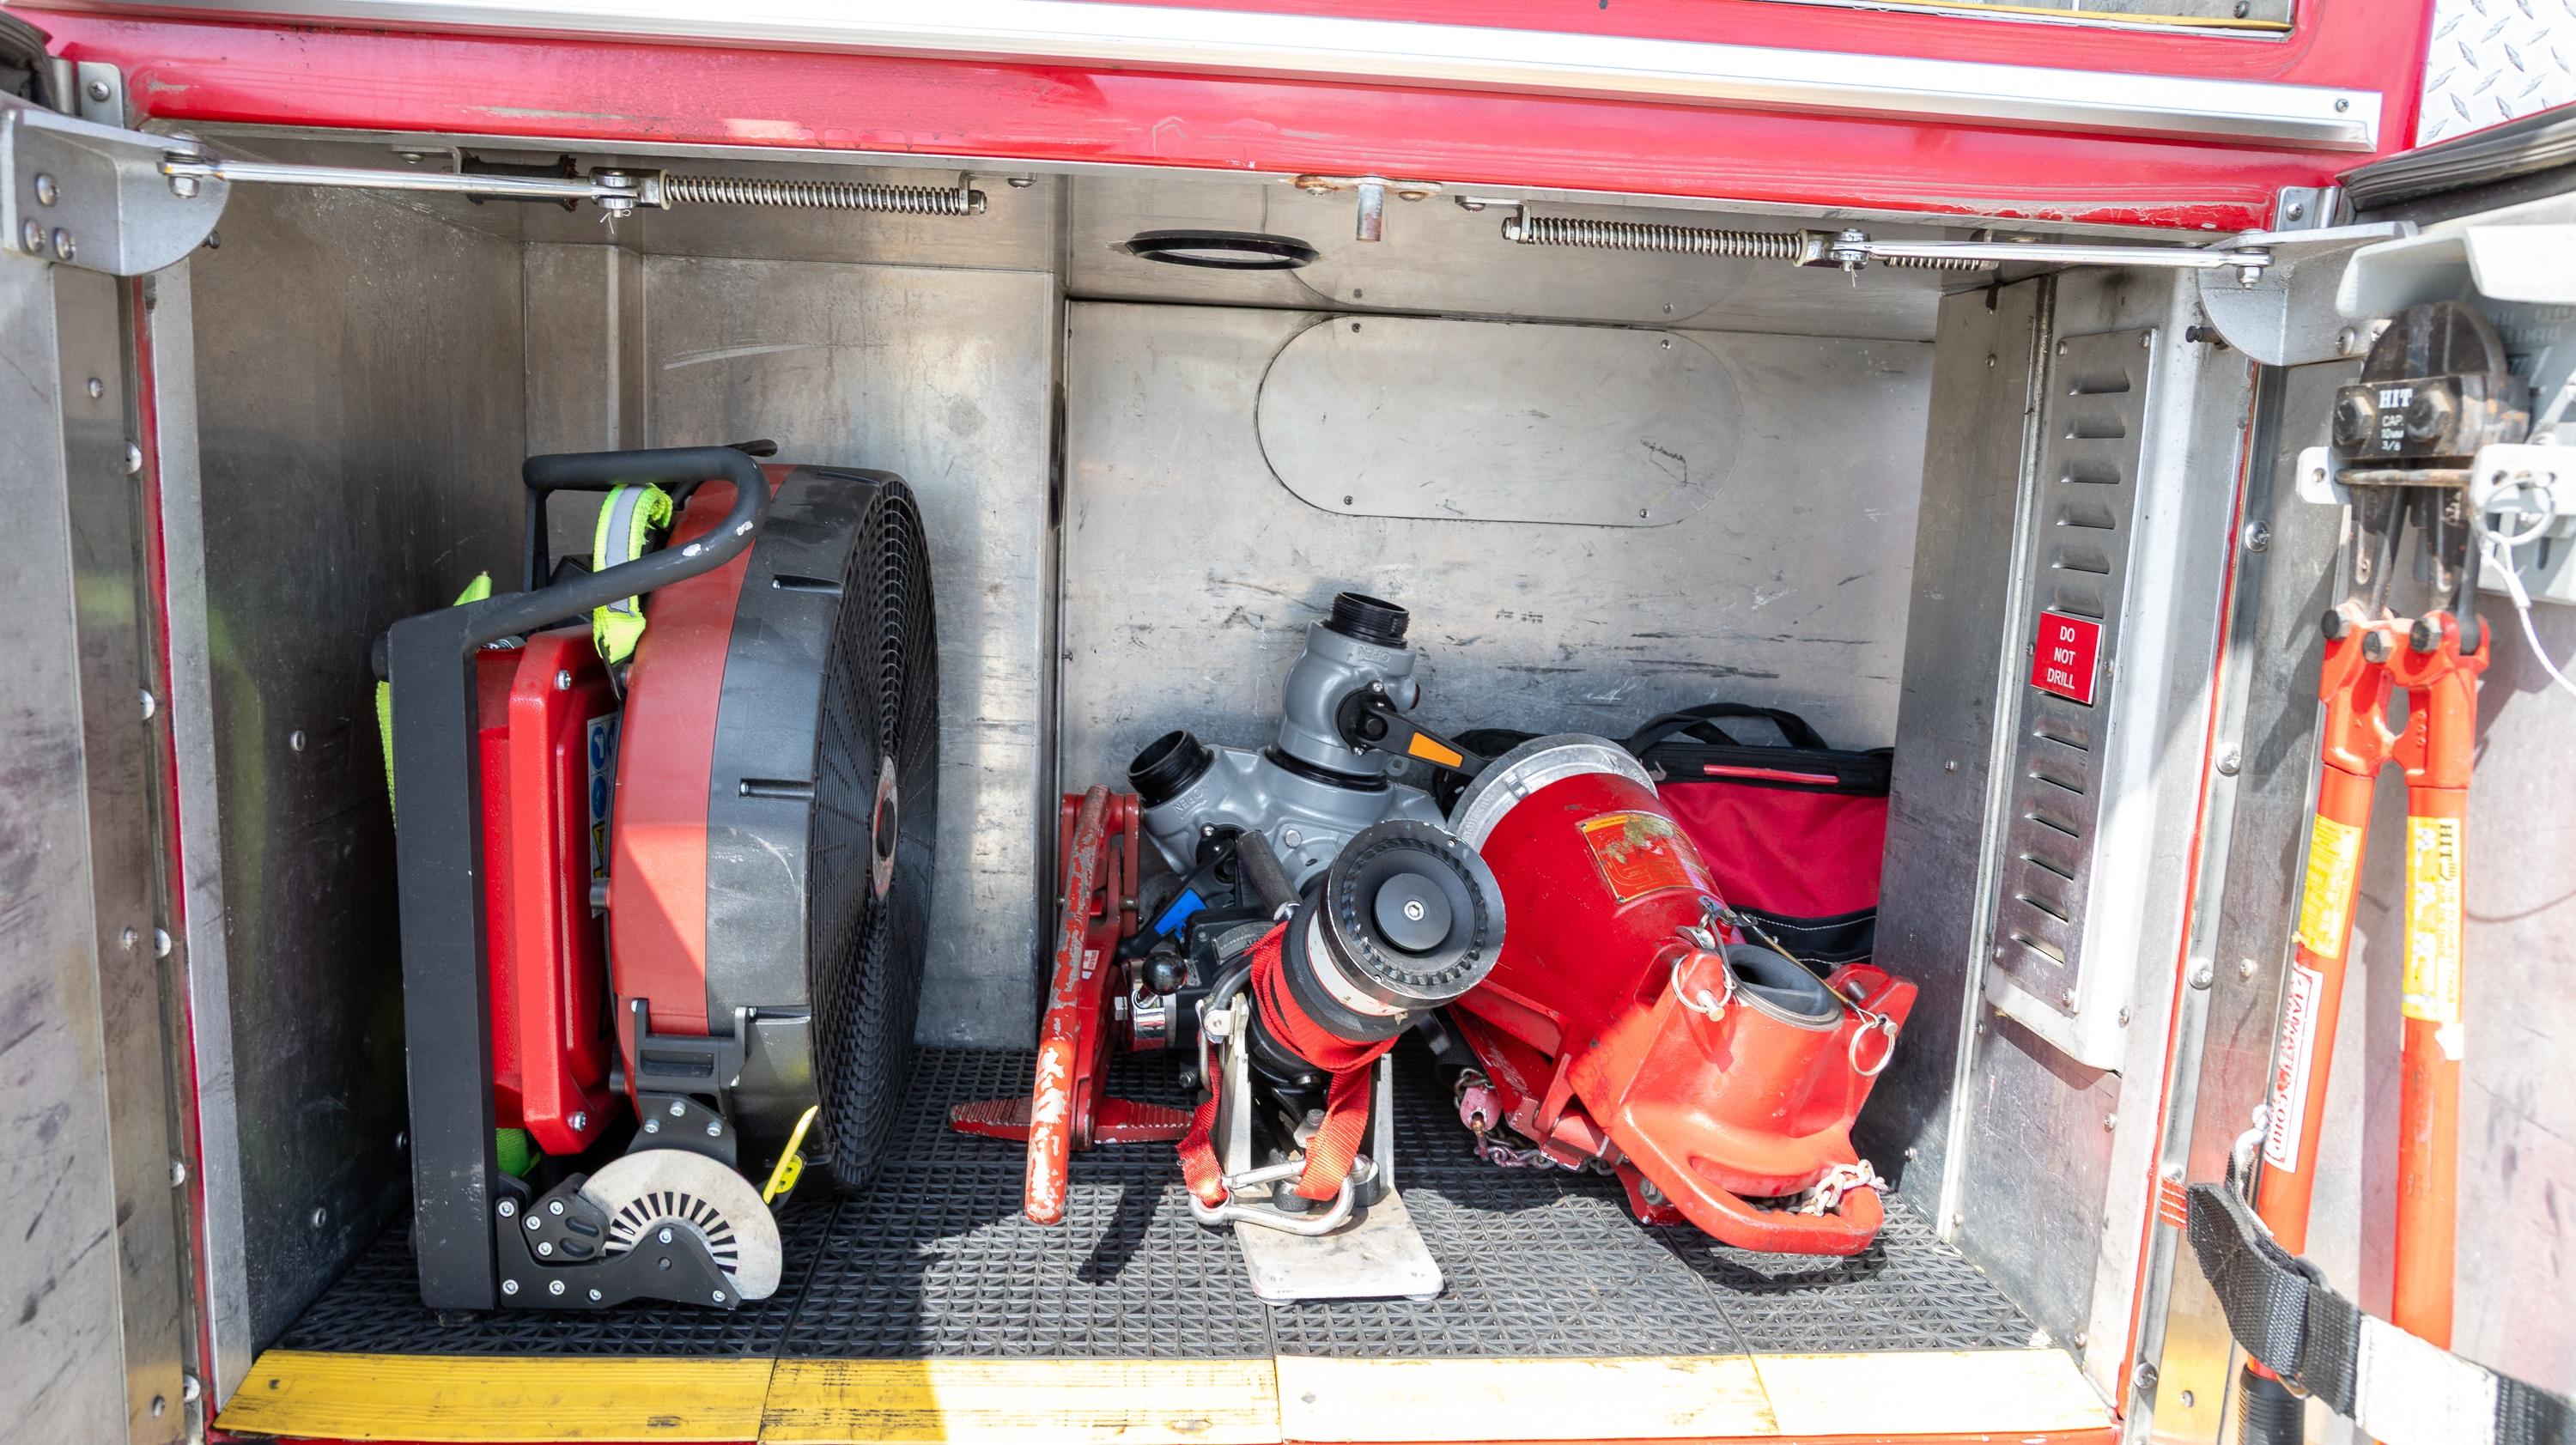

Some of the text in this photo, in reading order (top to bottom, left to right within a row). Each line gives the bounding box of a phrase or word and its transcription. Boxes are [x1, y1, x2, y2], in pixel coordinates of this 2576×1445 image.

[2379, 388, 2413, 409] HIT
[2059, 625, 2075, 643] DO
[2053, 647, 2076, 666] NOT
[2046, 667, 2075, 689] DRILL
[2439, 823, 2453, 860] HIT
